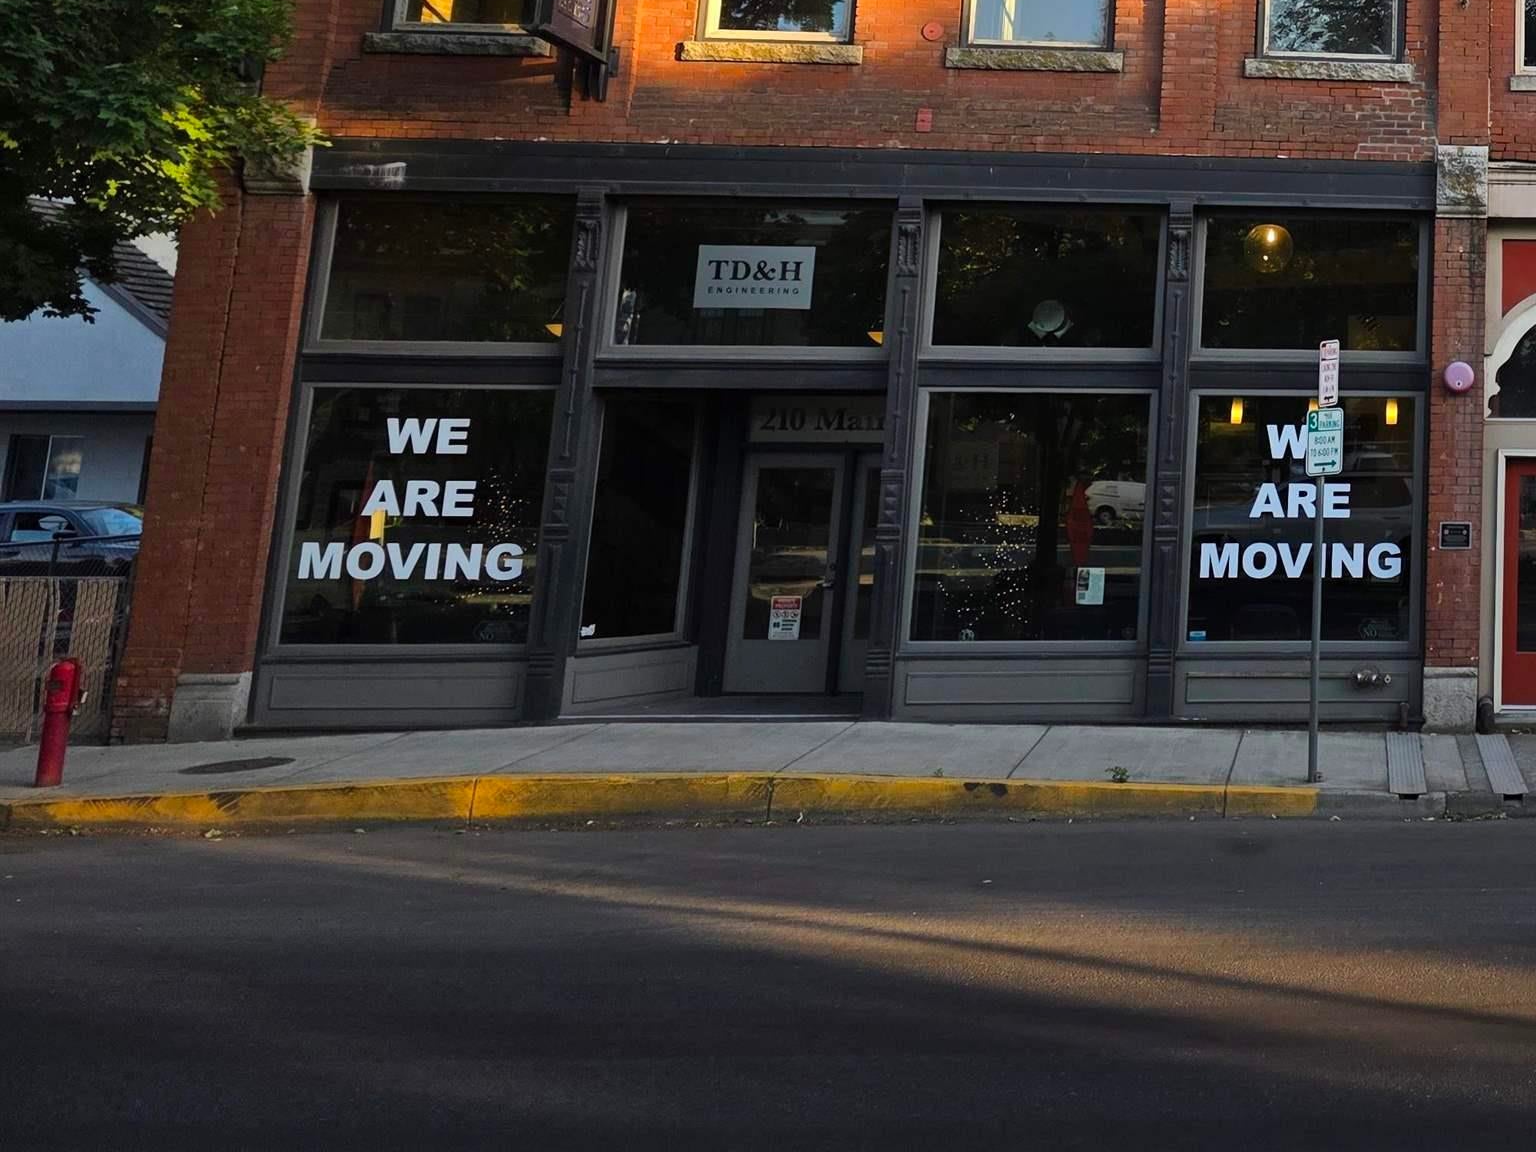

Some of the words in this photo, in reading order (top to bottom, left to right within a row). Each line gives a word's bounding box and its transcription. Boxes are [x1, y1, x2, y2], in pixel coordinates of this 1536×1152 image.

[708, 260, 803, 281] TD&H
[707, 286, 800, 295] ENGINEERING
[386, 418, 471, 455] WE
[760, 407, 806, 431] 210
[1310, 413, 1318, 429] 3
[1266, 424, 1309, 459] W
[361, 479, 477, 517] ARE
[1249, 483, 1351, 518] ARE
[297, 542, 524, 580] MOVING
